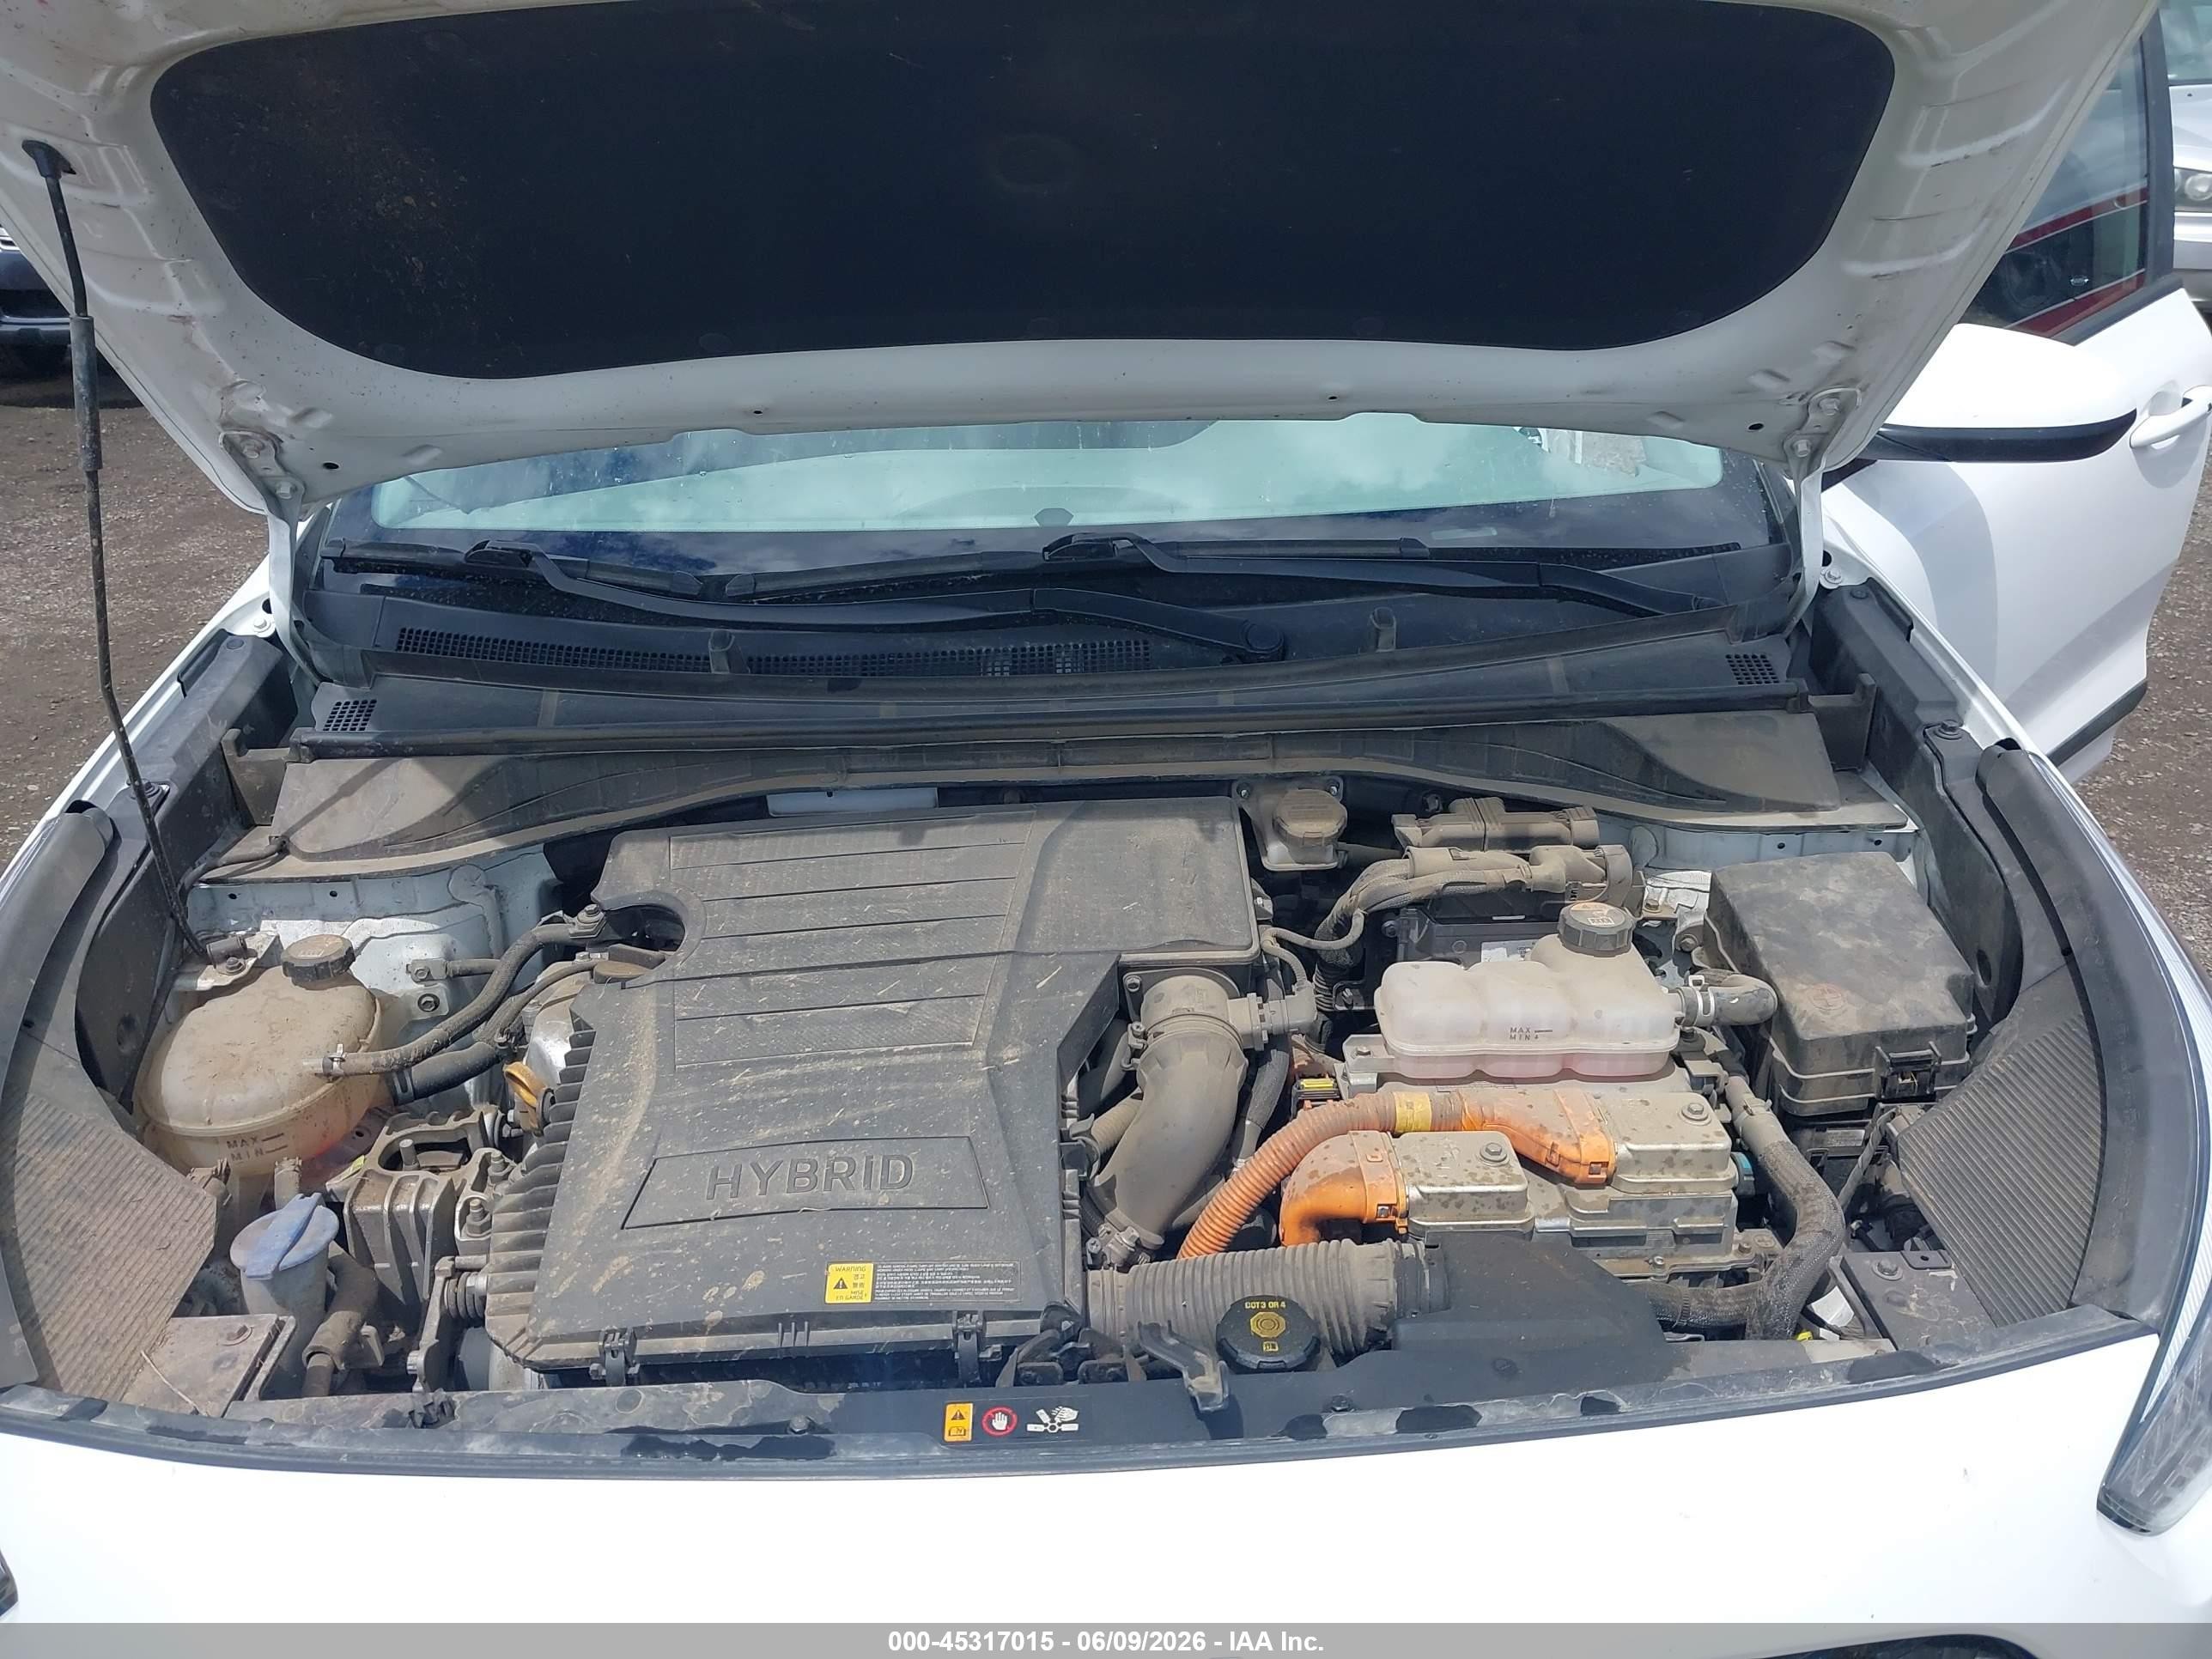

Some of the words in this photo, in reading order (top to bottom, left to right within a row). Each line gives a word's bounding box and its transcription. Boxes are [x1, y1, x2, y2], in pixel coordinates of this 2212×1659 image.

[226, 1137, 258, 1149] MAX
[230, 1148, 264, 1161] MIN
[706, 1154, 914, 1200] HYBRID
